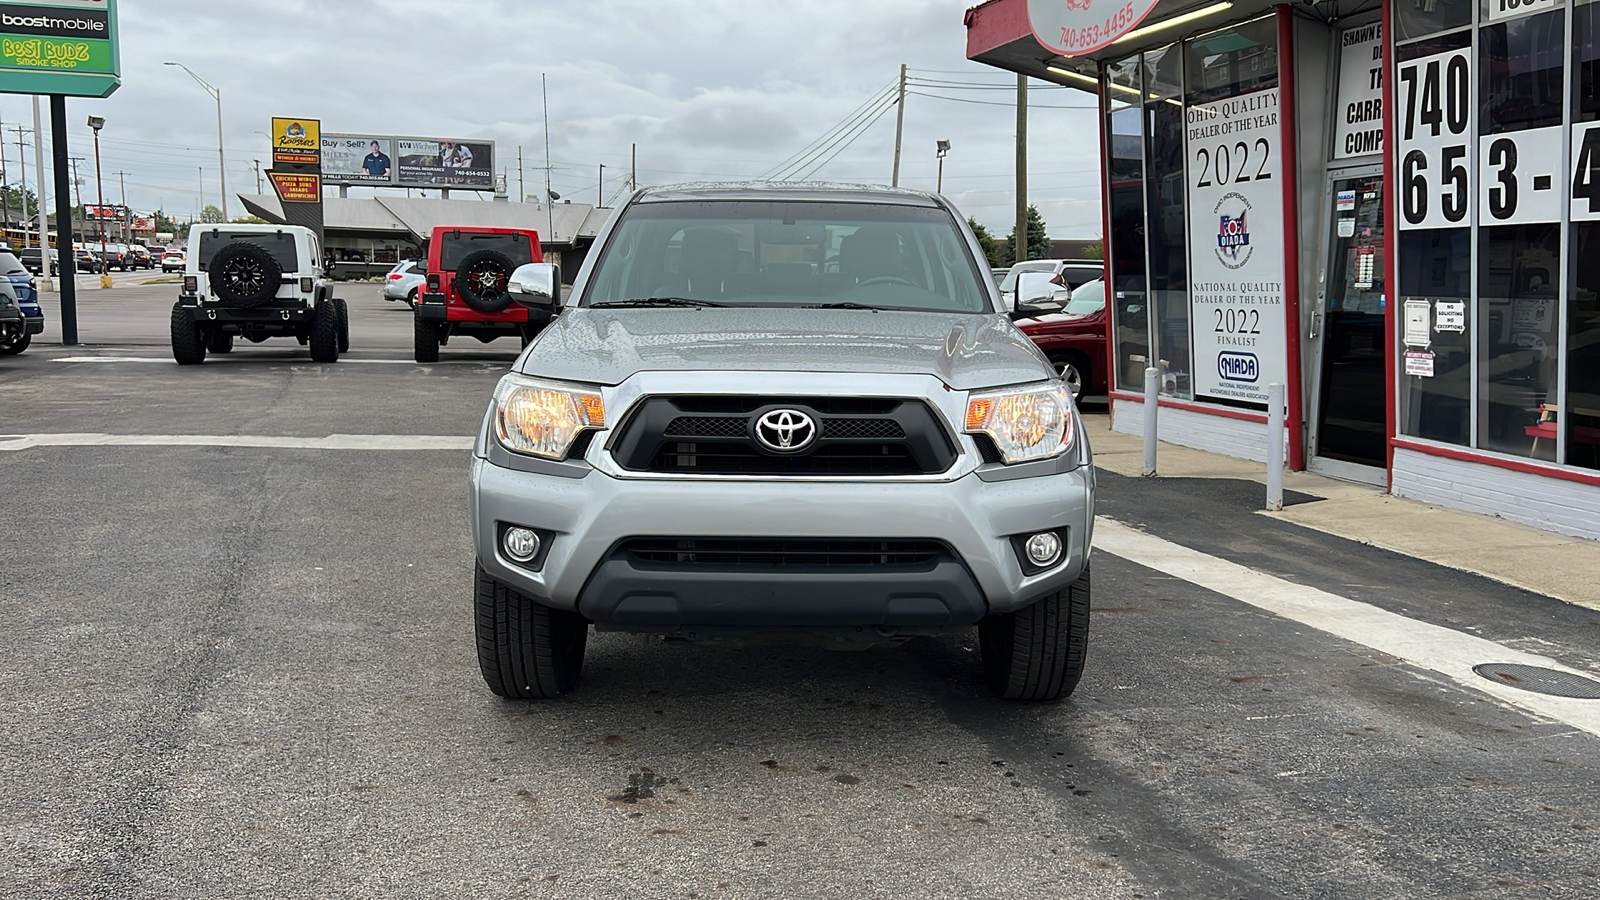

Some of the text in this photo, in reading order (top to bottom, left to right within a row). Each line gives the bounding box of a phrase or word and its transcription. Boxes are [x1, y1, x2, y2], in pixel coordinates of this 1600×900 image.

[1059, 1, 1133, 48] 740-653-4455
[1343, 25, 1375, 47] SHAWN
[16, 57, 76, 68] SMOKE SHOP
[1187, 92, 1278, 124] OHIO QUALITY
[1401, 54, 1469, 141] 740
[1346, 98, 1383, 125] CARR
[1189, 112, 1278, 141] DEALER OF THE YEAR
[278, 135, 315, 147] Roosters
[322, 139, 338, 148] Buy
[346, 140, 366, 148] Sell?
[412, 142, 438, 150] Wichert
[1345, 129, 1384, 155] COMP
[1196, 137, 1272, 188] 2022
[1213, 192, 1253, 214] OHIO INDEPENDENT
[1221, 234, 1245, 246] OIADA
[1193, 282, 1282, 294] NATIONAL QUALITY
[1194, 295, 1281, 305] DEALER OF THE YEAR
[1214, 308, 1261, 335] 2022
[1217, 335, 1257, 347] FINALIST
[1209, 388, 1231, 396] AUTOMOBILE
